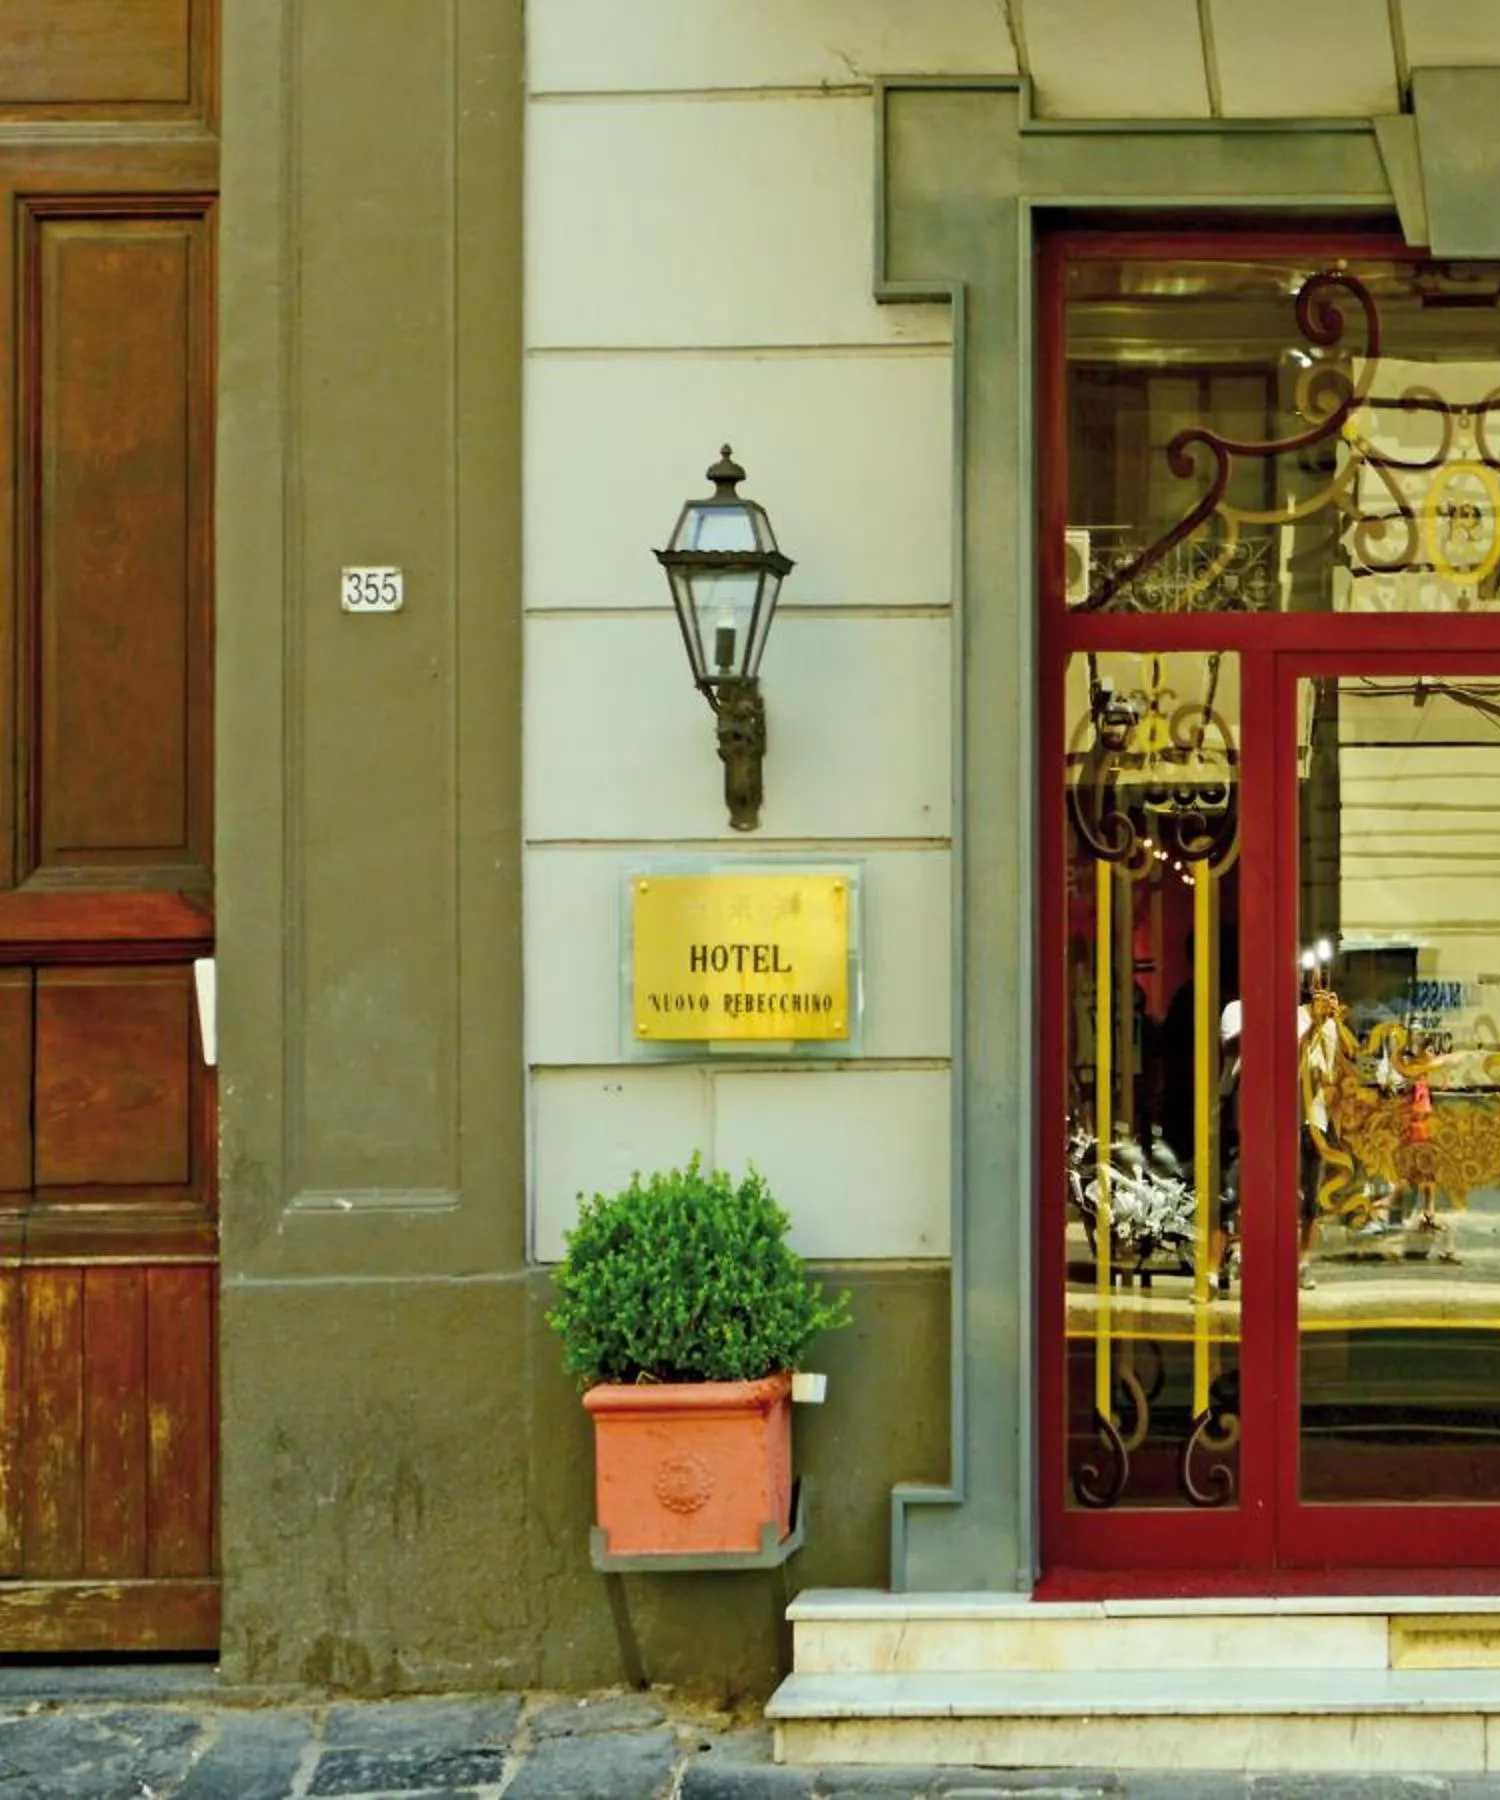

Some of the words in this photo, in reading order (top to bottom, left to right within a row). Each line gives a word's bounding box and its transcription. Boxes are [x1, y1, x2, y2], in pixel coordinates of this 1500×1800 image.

[347, 572, 398, 605] 355
[689, 943, 793, 973] HOTEL
[723, 993, 833, 1014] REBECCHINO
